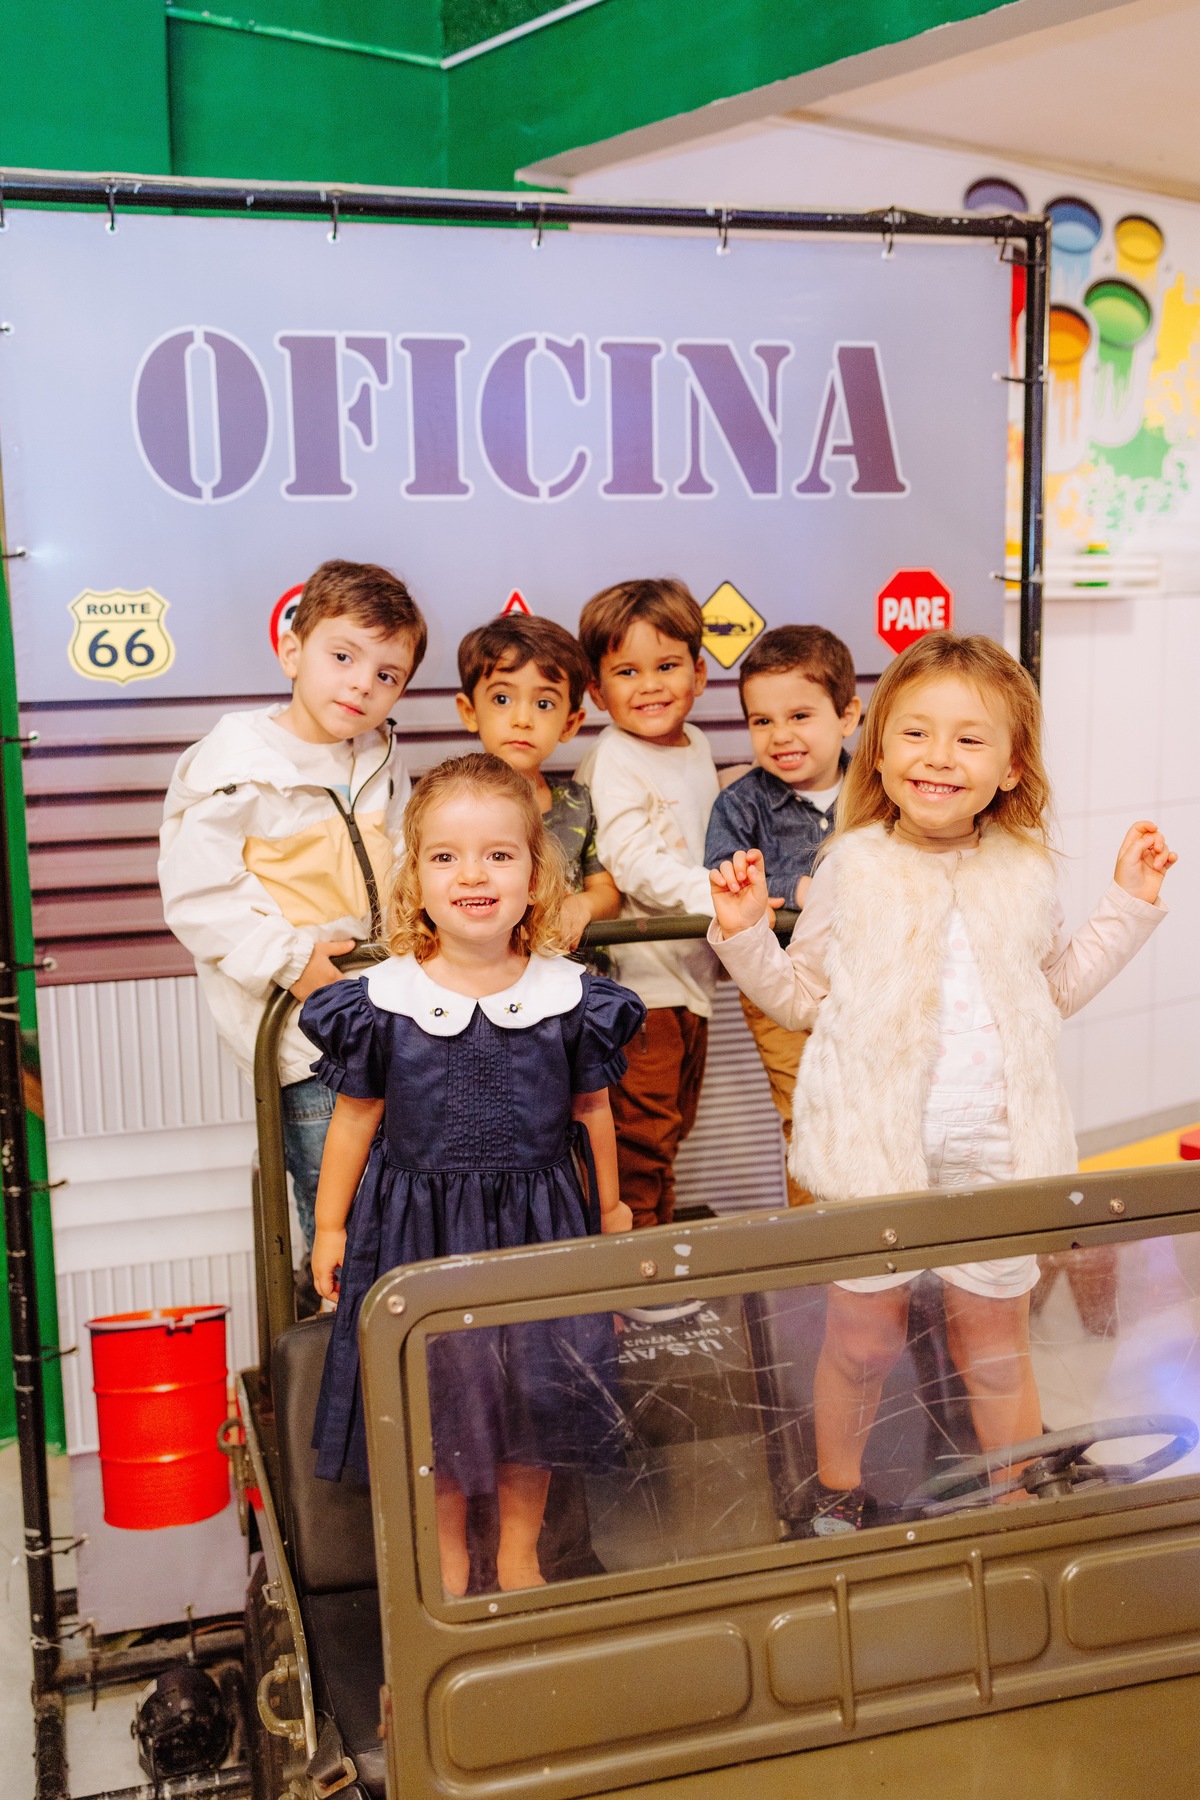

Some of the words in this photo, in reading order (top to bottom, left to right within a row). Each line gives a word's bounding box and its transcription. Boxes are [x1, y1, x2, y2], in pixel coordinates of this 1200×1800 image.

[132, 325, 910, 503] OFICINA
[86, 602, 152, 616] ROUTE
[881, 596, 946, 631] PARE
[88, 628, 156, 668] 66
